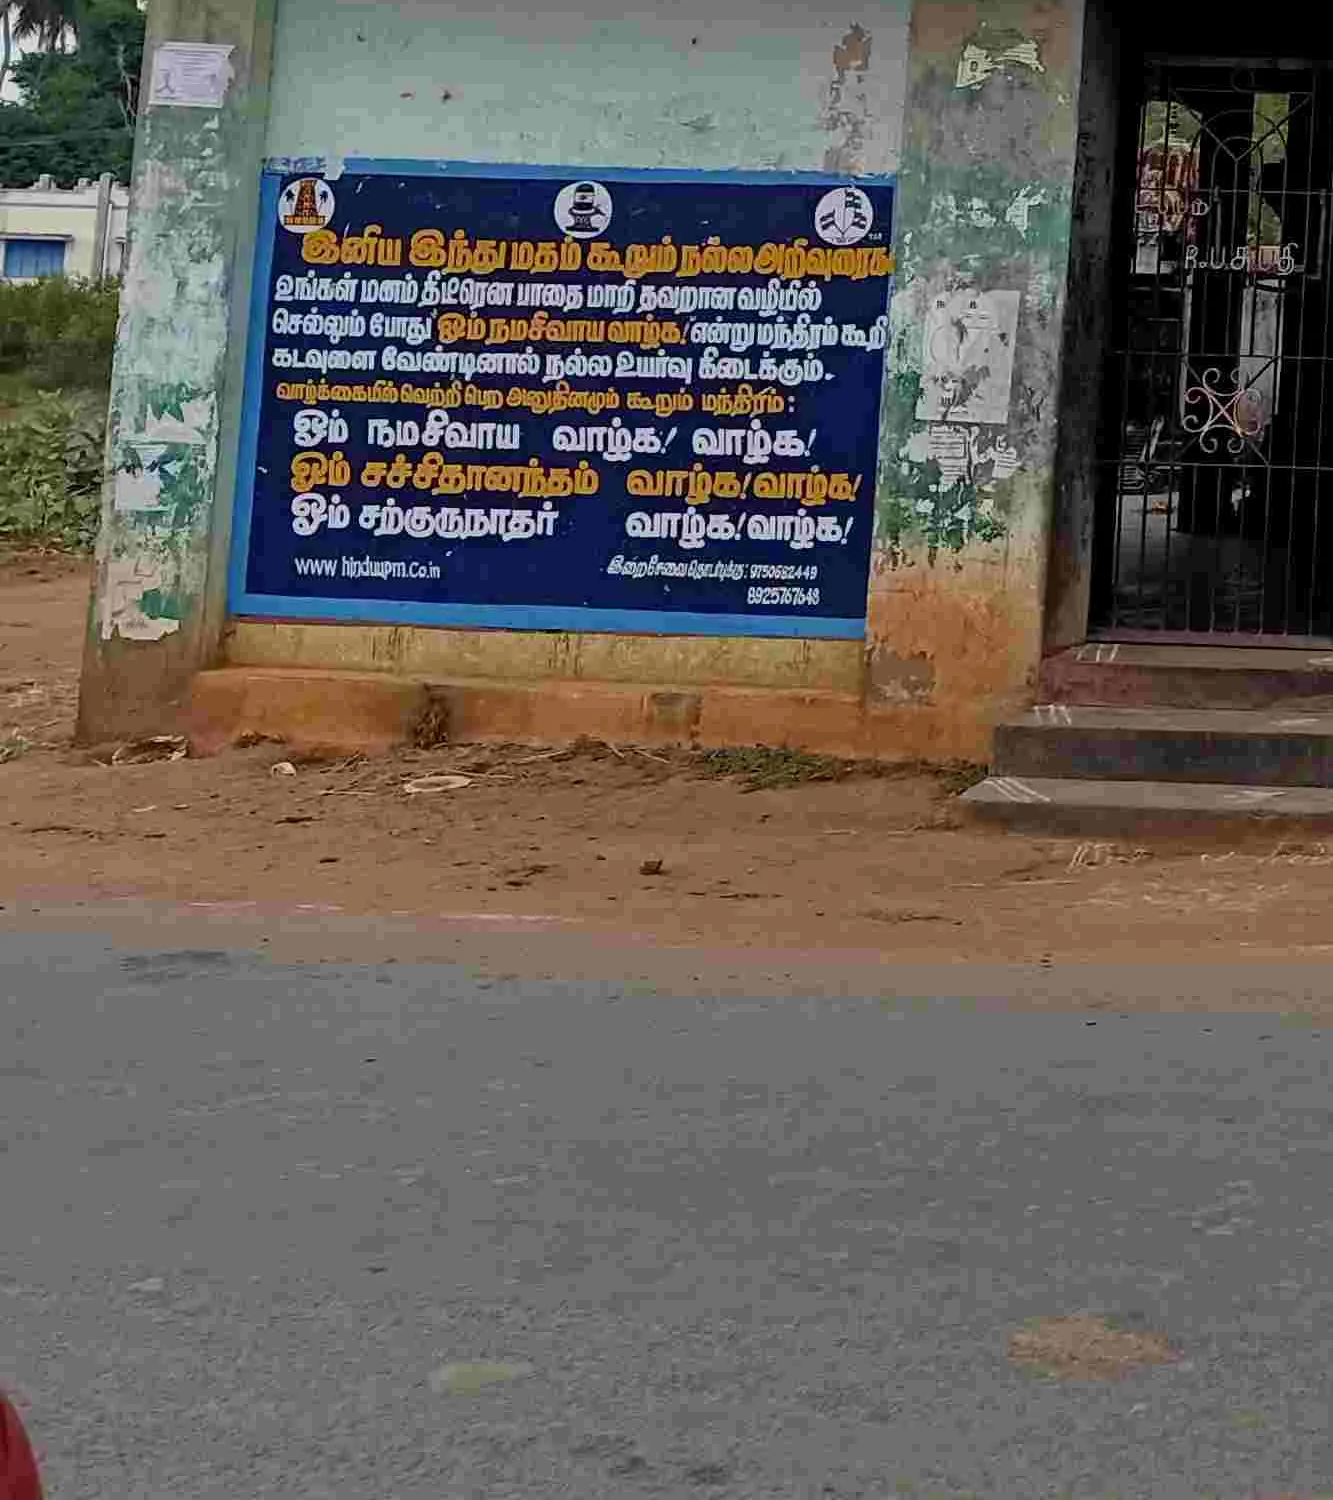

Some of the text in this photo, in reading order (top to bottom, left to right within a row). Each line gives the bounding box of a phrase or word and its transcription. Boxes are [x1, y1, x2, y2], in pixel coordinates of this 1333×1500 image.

[302, 224, 401, 265] இனிய
[409, 228, 505, 274] இந்து
[510, 232, 582, 271] மதம்
[587, 235, 677, 278] கூறும்
[677, 235, 753, 278] நல்ல
[274, 269, 822, 316] உங்கள் மனம் திடீரென பாதை மாறி தவறான வழியில்
[272, 307, 365, 344] செல்லும்
[369, 309, 432, 345] போது
[485, 311, 601, 345] நமசிவாய
[690, 316, 756, 351] என்று
[757, 313, 840, 350] மந்திரம்
[840, 316, 890, 351] கூறி
[272, 347, 377, 374] கடவுளை
[381, 345, 540, 377] வேண்டினால்
[542, 348, 612, 382] நல்ல
[614, 350, 693, 383] உயர்வு
[276, 379, 398, 405] வாழ்க்கையில்
[400, 380, 463, 408] வெற்றி
[464, 384, 504, 410] பெற
[505, 381, 620, 414] அனுதினமும்
[627, 387, 693, 417] கூறும்
[293, 408, 817, 464] ஓம் நமசிவாய வாழ்க! வாழ்க!
[290, 451, 863, 506] ஓம் சச்சிதானந்தம் வாழ்க! வாழ்க!
[290, 492, 855, 549] ஓம் சற்குருநாதர் வாழ்க! வாழ்க!
